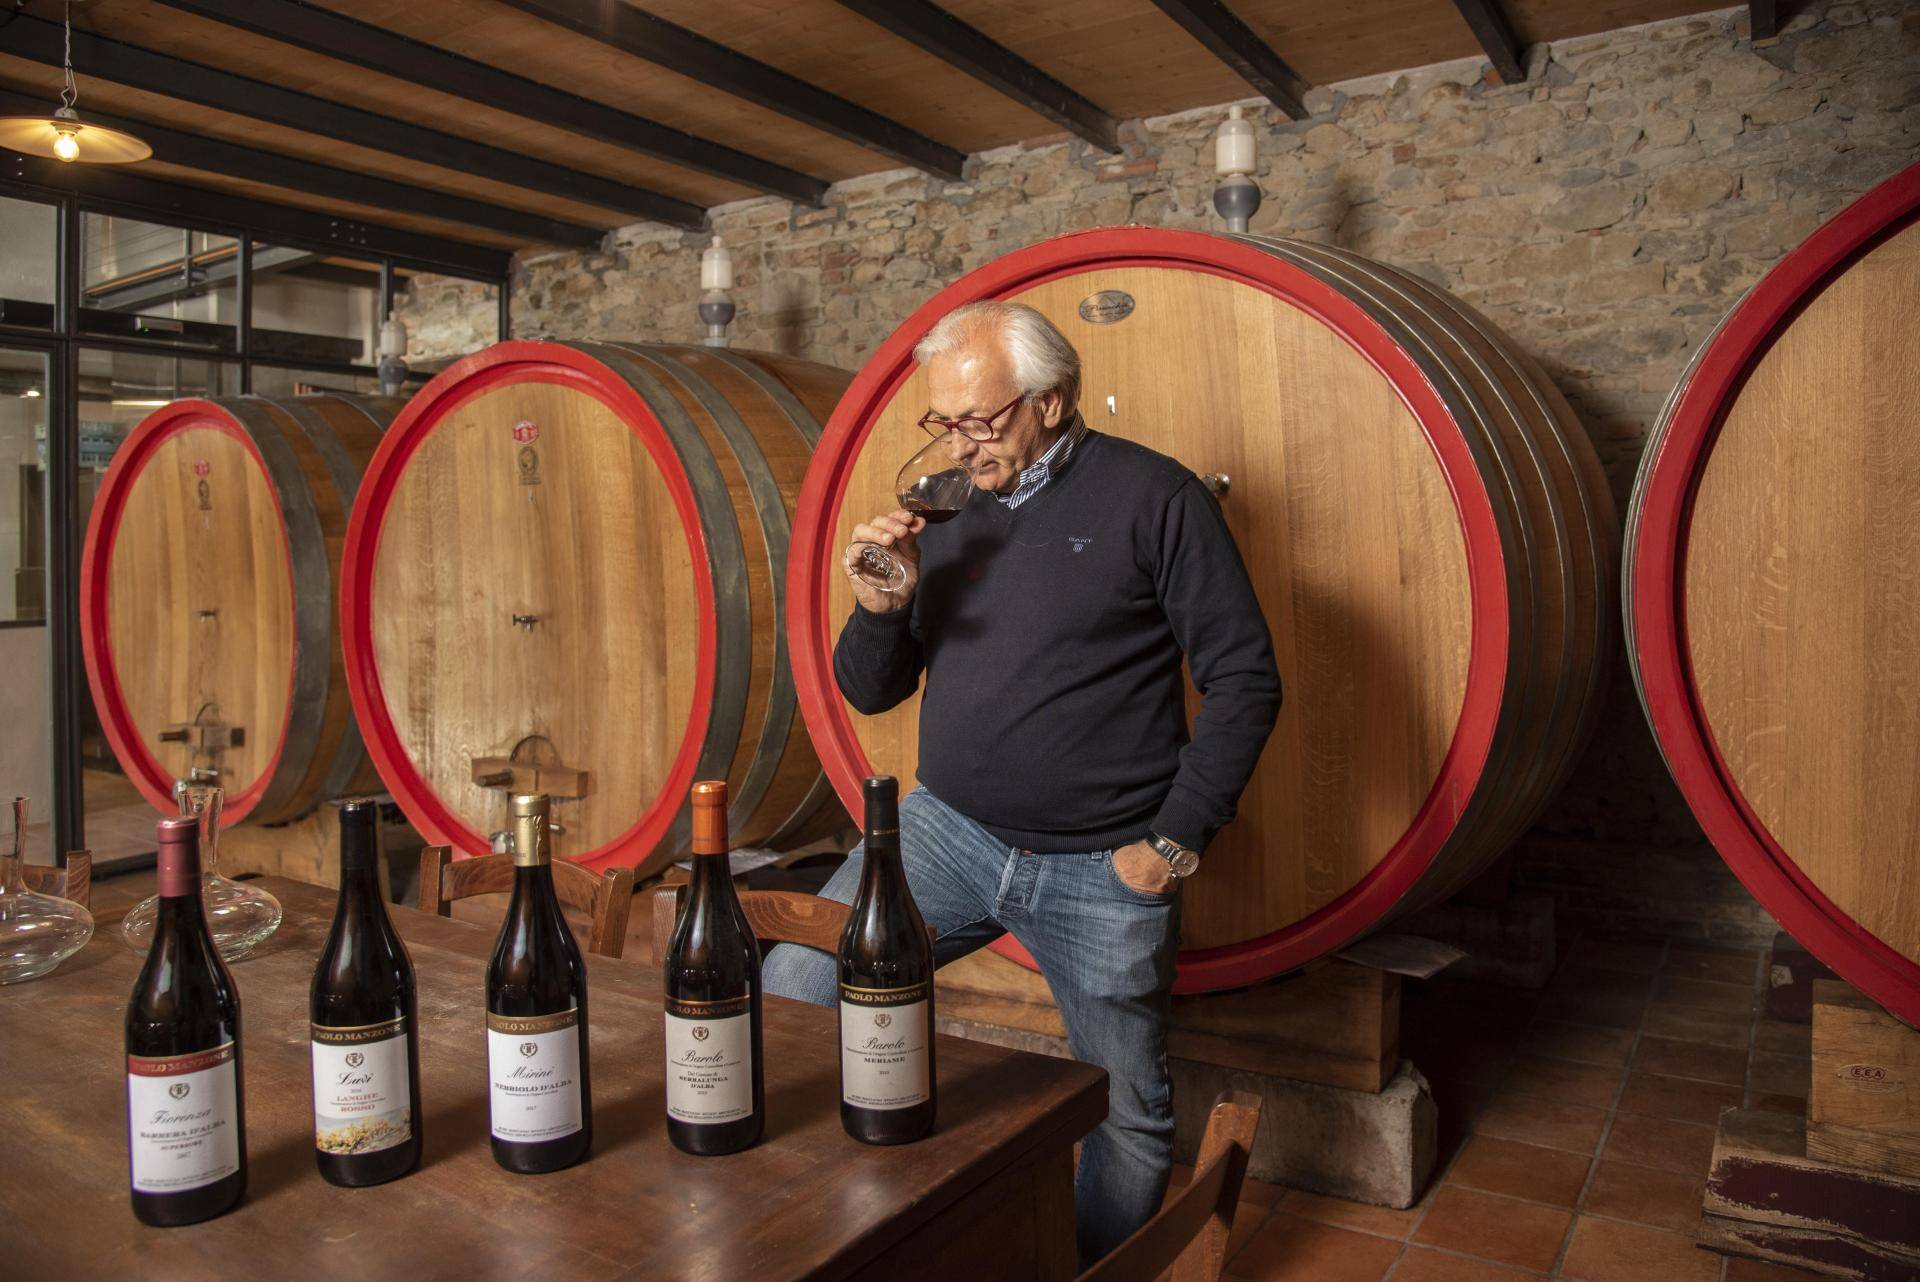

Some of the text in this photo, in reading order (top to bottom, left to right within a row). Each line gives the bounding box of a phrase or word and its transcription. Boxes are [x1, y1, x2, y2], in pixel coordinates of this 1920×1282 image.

[844, 990, 922, 1002] PAOLO MANZONE
[345, 1023, 401, 1041] MANZONE
[862, 1036, 906, 1050] Barolo
[681, 1049, 724, 1063] Barolo
[1854, 1068, 1882, 1077] EEA
[540, 1079, 573, 1092] D'ALBA
[336, 1092, 379, 1102] LANGHE
[340, 1104, 376, 1113] ROSSO
[150, 1108, 212, 1125] Fiorenza
[189, 1120, 226, 1136] D'ALBA
